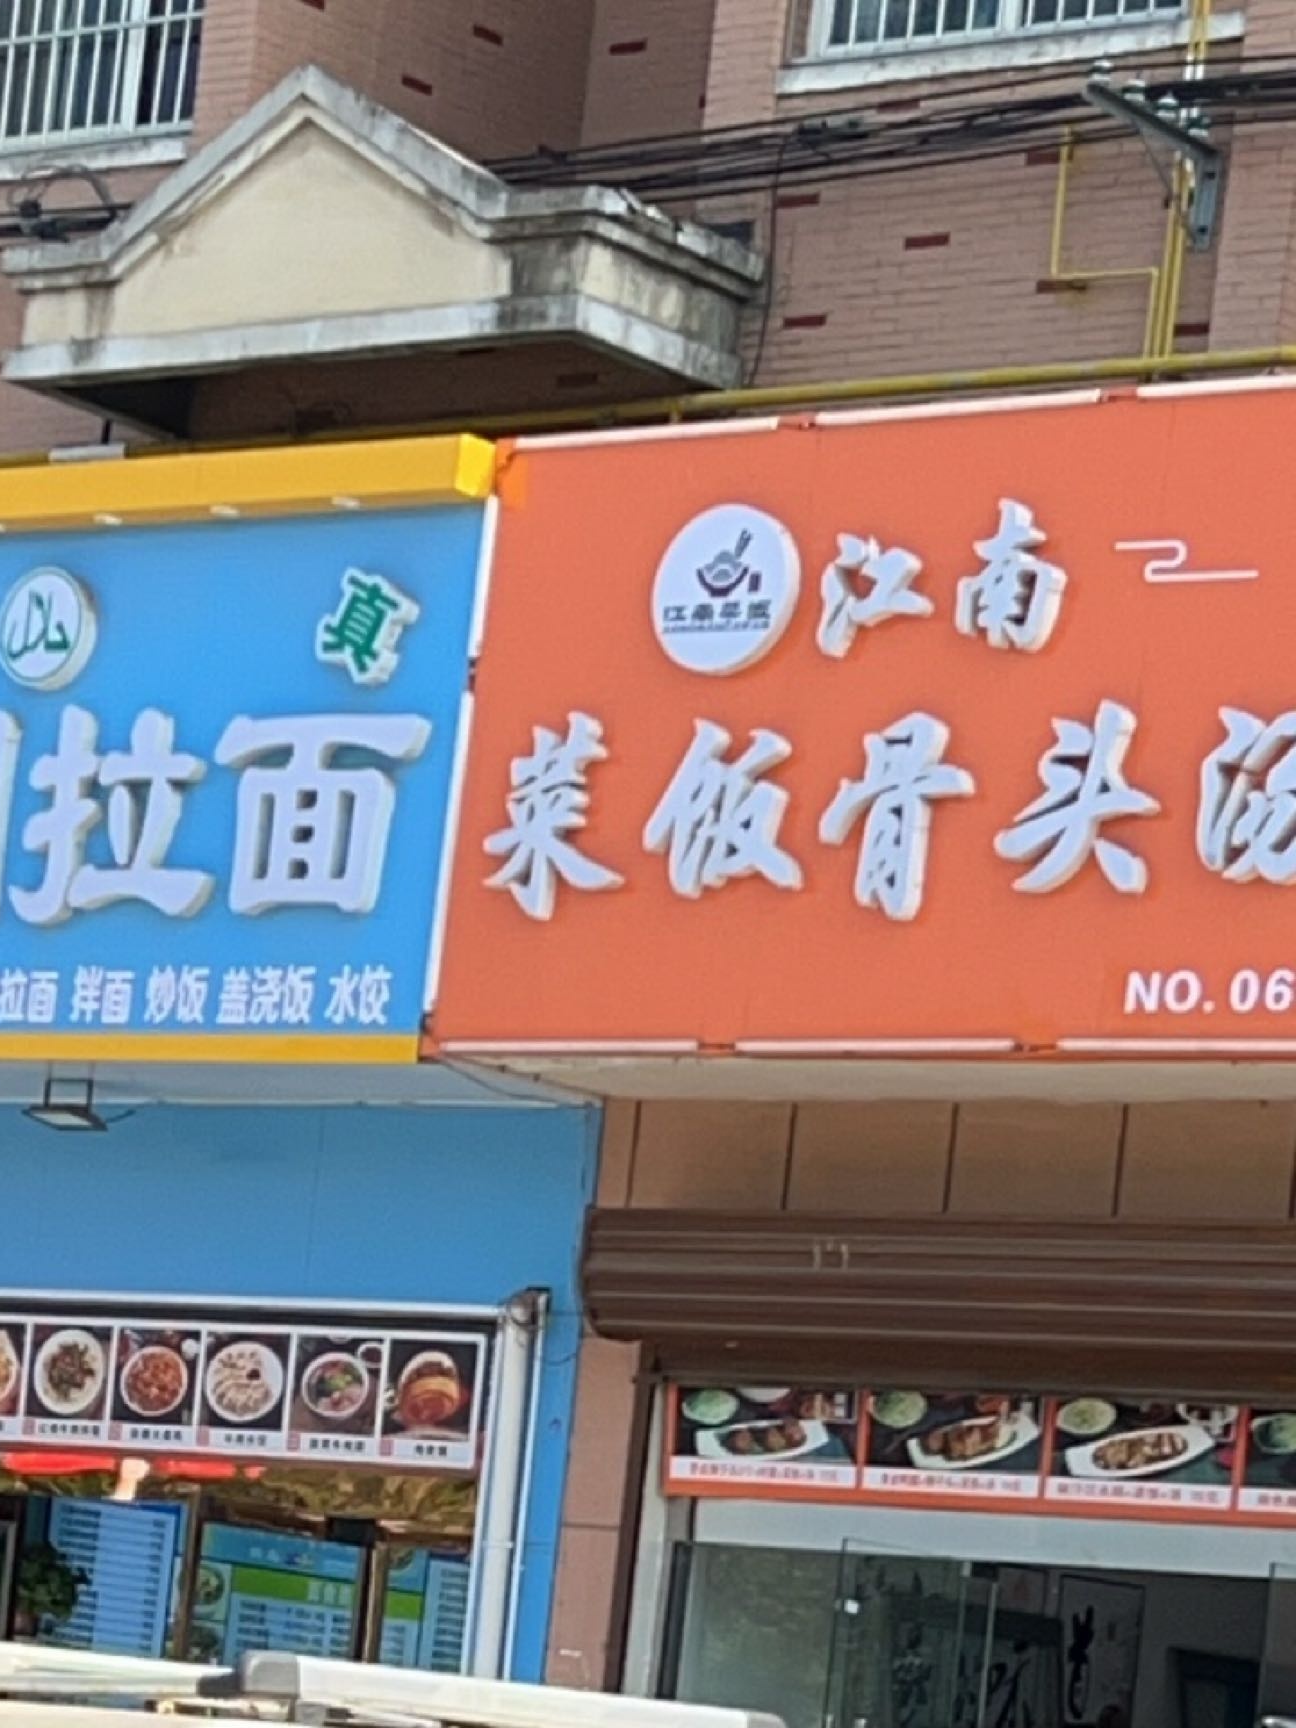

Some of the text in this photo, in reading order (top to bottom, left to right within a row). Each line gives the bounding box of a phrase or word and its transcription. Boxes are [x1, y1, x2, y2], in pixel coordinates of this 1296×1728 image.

[318, 569, 410, 681] 真
[815, 496, 1068, 659] 江南
[143, 964, 211, 1024] 炒饭
[215, 964, 317, 1025] 盖浇饭
[323, 964, 394, 1025] 水饺
